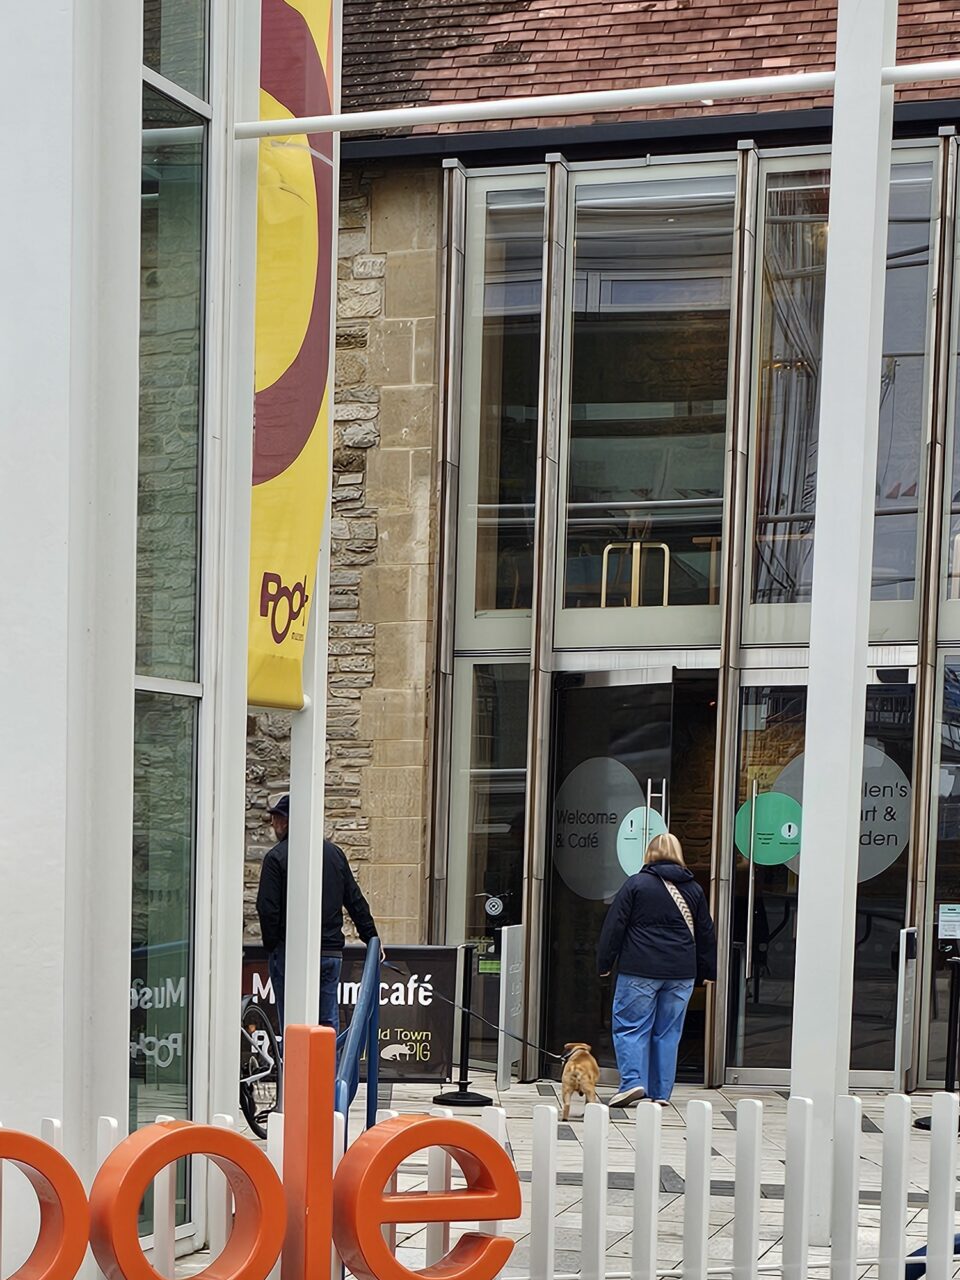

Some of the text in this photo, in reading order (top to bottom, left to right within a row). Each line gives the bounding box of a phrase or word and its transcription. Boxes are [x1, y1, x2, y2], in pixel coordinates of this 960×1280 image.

[864, 782, 908, 798] len's
[556, 809, 618, 825] Welcome
[883, 805, 897, 821] &
[555, 832, 599, 849] & Café
[378, 973, 433, 1006] café
[394, 1028, 432, 1041] Town
